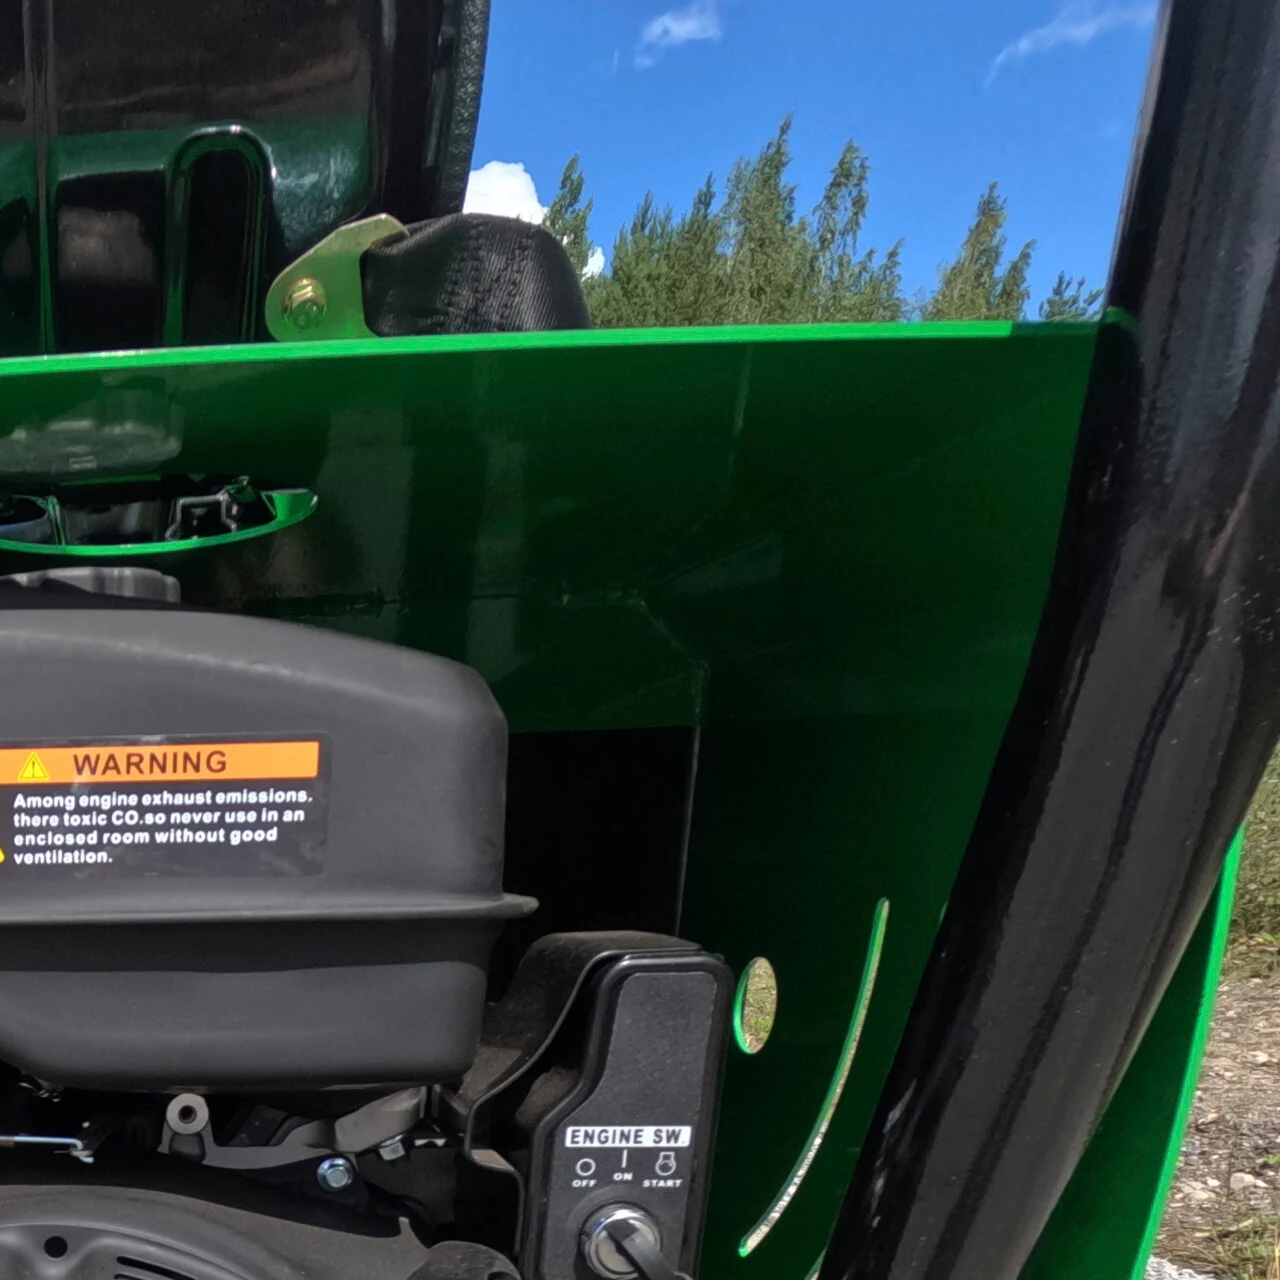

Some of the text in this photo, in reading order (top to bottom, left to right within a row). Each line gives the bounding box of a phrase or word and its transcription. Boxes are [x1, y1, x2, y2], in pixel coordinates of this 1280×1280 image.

[73, 750, 227, 776] WARNING
[14, 793, 75, 811] Among
[78, 791, 138, 810] engine
[141, 790, 213, 806] exhaust
[13, 812, 59, 828] there
[63, 811, 108, 827] toxic
[170, 811, 221, 825] never
[225, 811, 257, 823] use
[261, 807, 279, 822] in
[282, 809, 305, 822] an
[14, 826, 278, 846] enclosed room without good
[13, 849, 113, 864] ventilation.
[570, 1128, 644, 1145] ENGINE
[571, 1179, 597, 1188] OFF
[612, 1172, 633, 1181] ON
[642, 1179, 683, 1188] START
